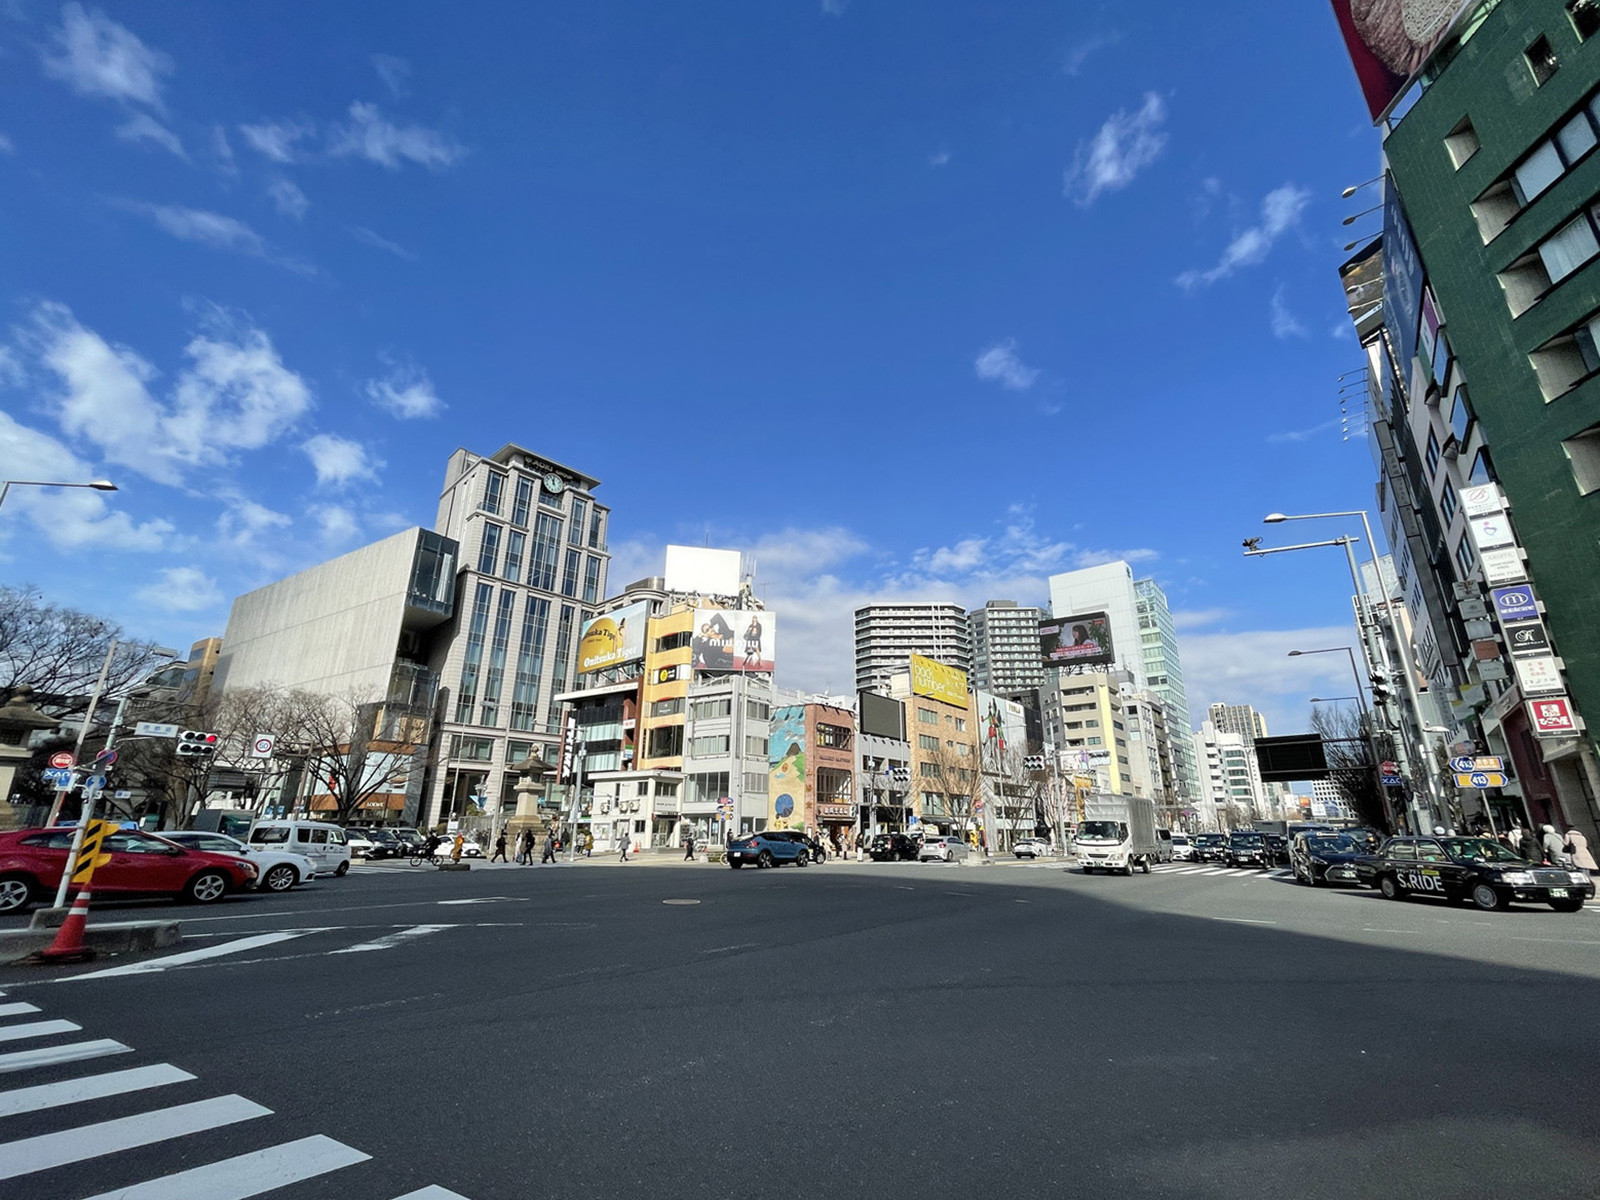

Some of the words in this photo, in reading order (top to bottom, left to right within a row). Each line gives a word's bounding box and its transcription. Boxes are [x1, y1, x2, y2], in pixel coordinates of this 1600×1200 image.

[584, 651, 616, 668] Onitsuka
[1459, 760, 1473, 769] 413
[1472, 775, 1487, 785] 413
[1397, 873, 1446, 892] S.RIDE
